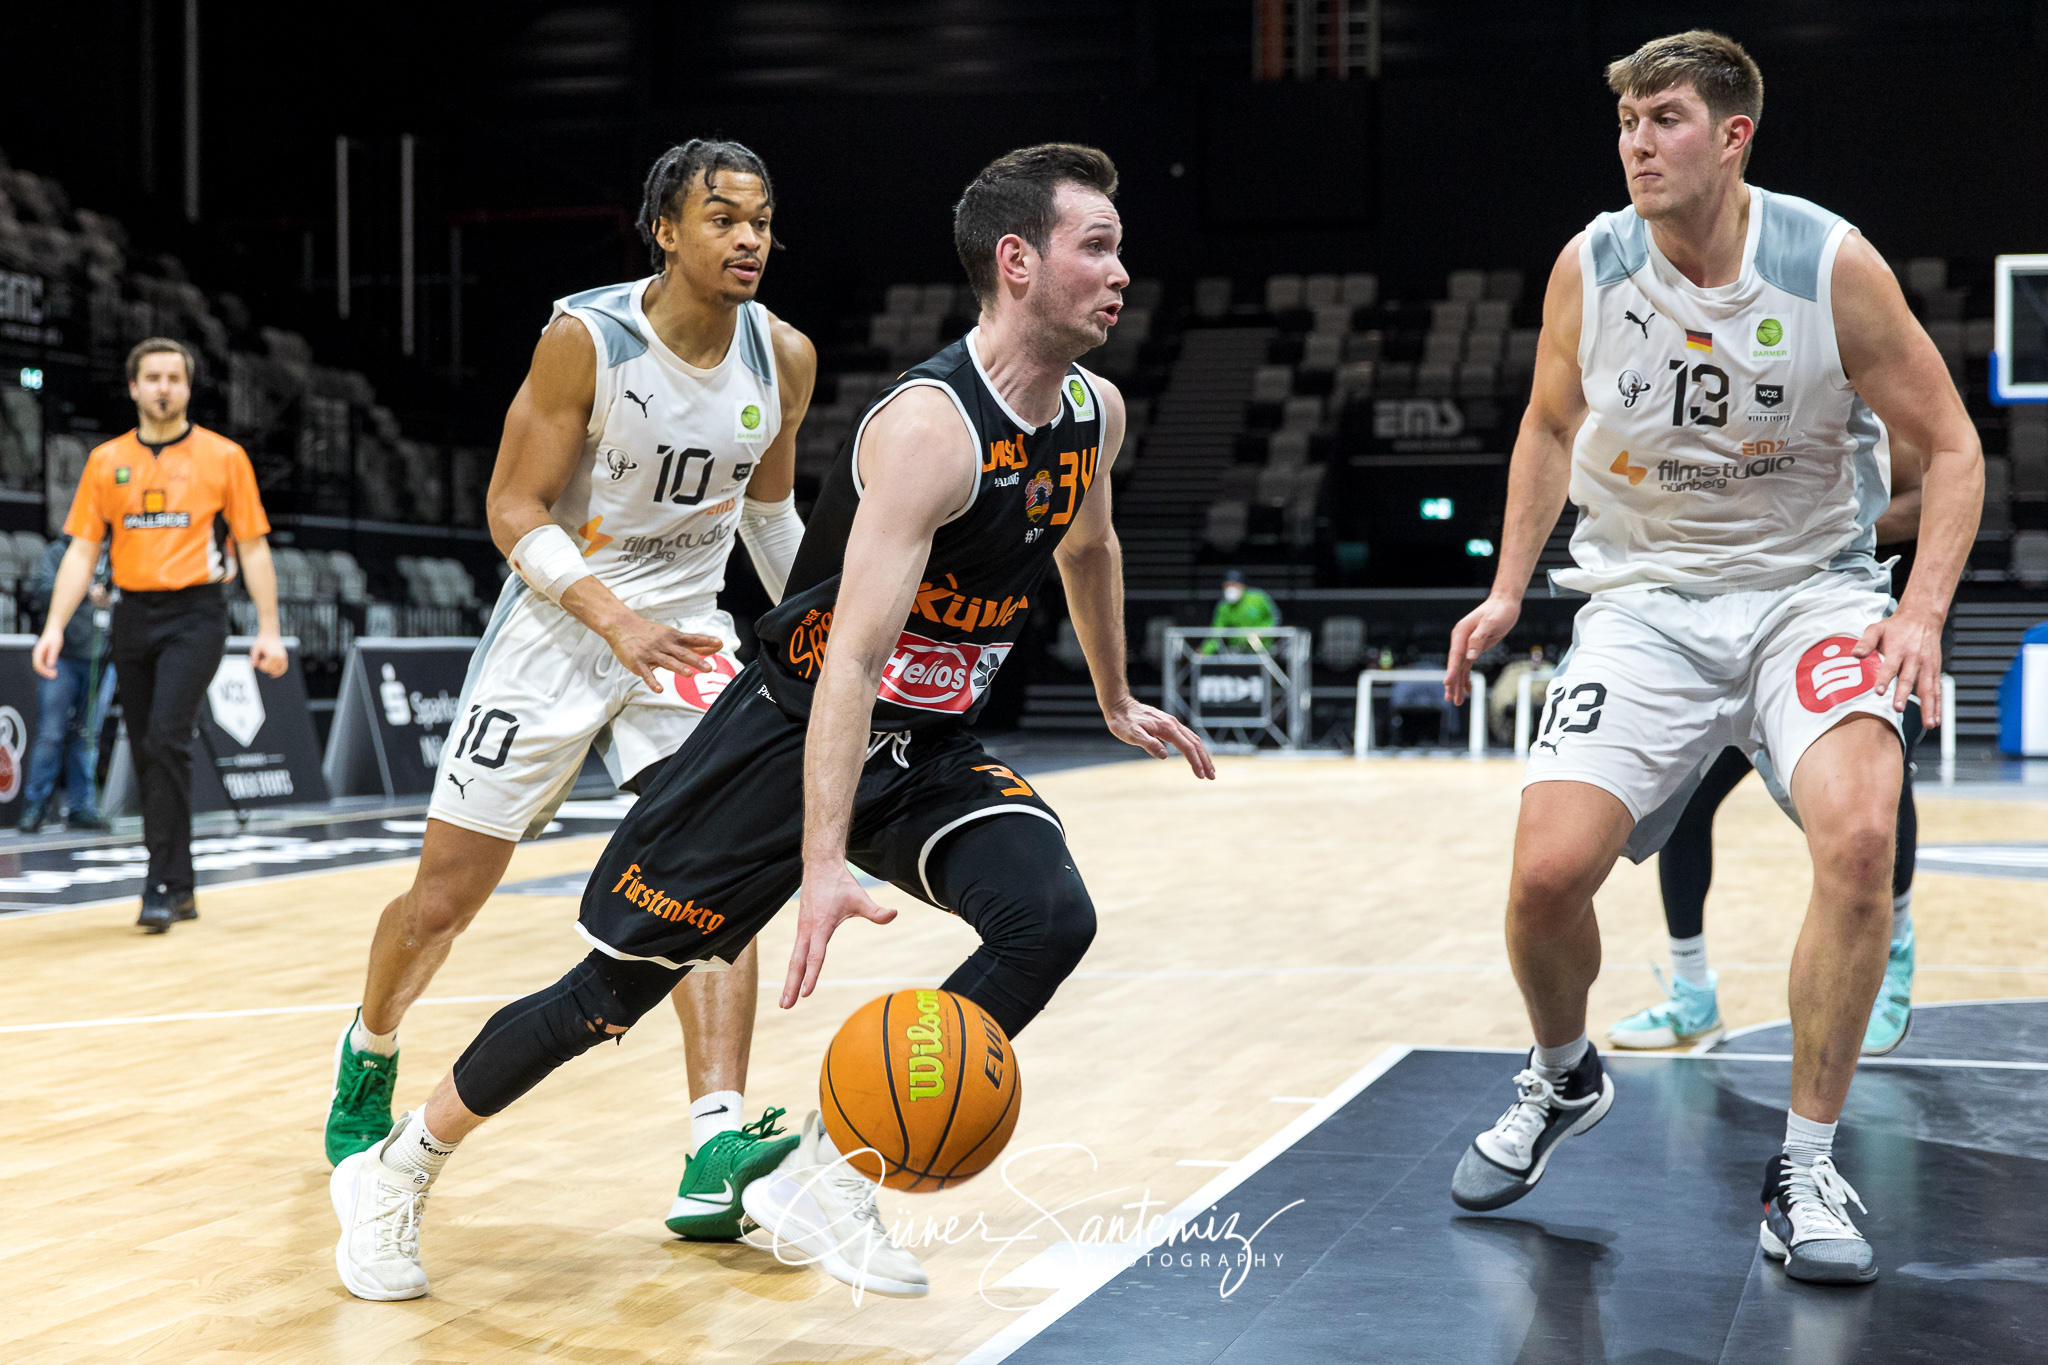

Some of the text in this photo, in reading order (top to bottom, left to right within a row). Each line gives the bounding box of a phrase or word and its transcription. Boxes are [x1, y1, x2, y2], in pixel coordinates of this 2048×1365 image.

[1669, 360, 1729, 428] 13
[653, 444, 715, 506] 10
[1657, 455, 1796, 482] filmstudio
[801, 609, 822, 626] DER
[884, 646, 967, 691] Helios
[1544, 682, 1608, 735] 13
[455, 705, 520, 770] 10
